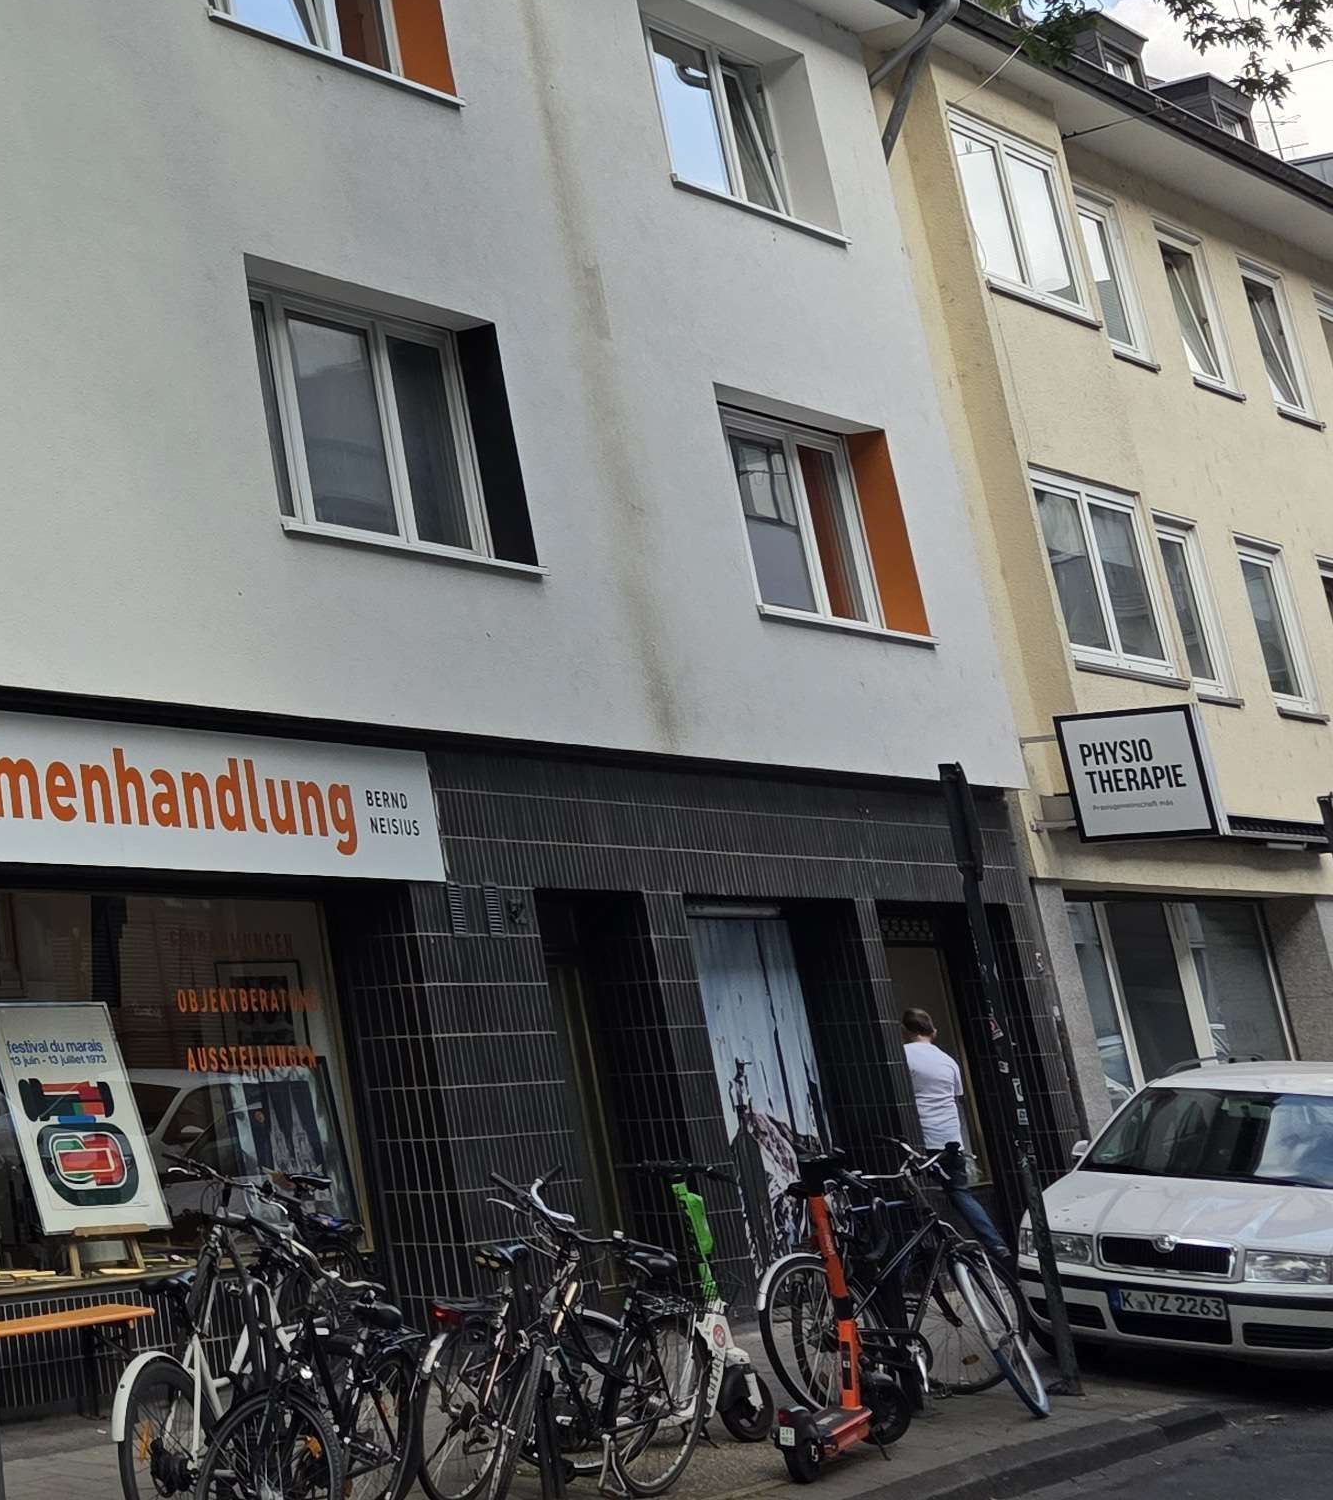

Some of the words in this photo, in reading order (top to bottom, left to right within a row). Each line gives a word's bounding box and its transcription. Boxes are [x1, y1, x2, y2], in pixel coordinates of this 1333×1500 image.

[1079, 738, 1153, 766] PHYSIO
[1085, 764, 1187, 794] THERAPIE
[365, 789, 408, 810] BERND
[370, 816, 421, 837] NEISIUS
[6, 1040, 48, 1054] festival
[50, 1040, 65, 1053] du
[66, 1039, 103, 1053] marais
[10, 1056, 21, 1066] 13
[24, 1055, 40, 1067] juin
[48, 1055, 58, 1065] 13
[61, 1055, 85, 1067] juillet
[86, 1054, 107, 1064] 1973
[186, 1045, 317, 1073] AUSSTELLUNGEN
[1145, 1293, 1173, 1313] YZ
[1174, 1296, 1223, 1318] 2263
